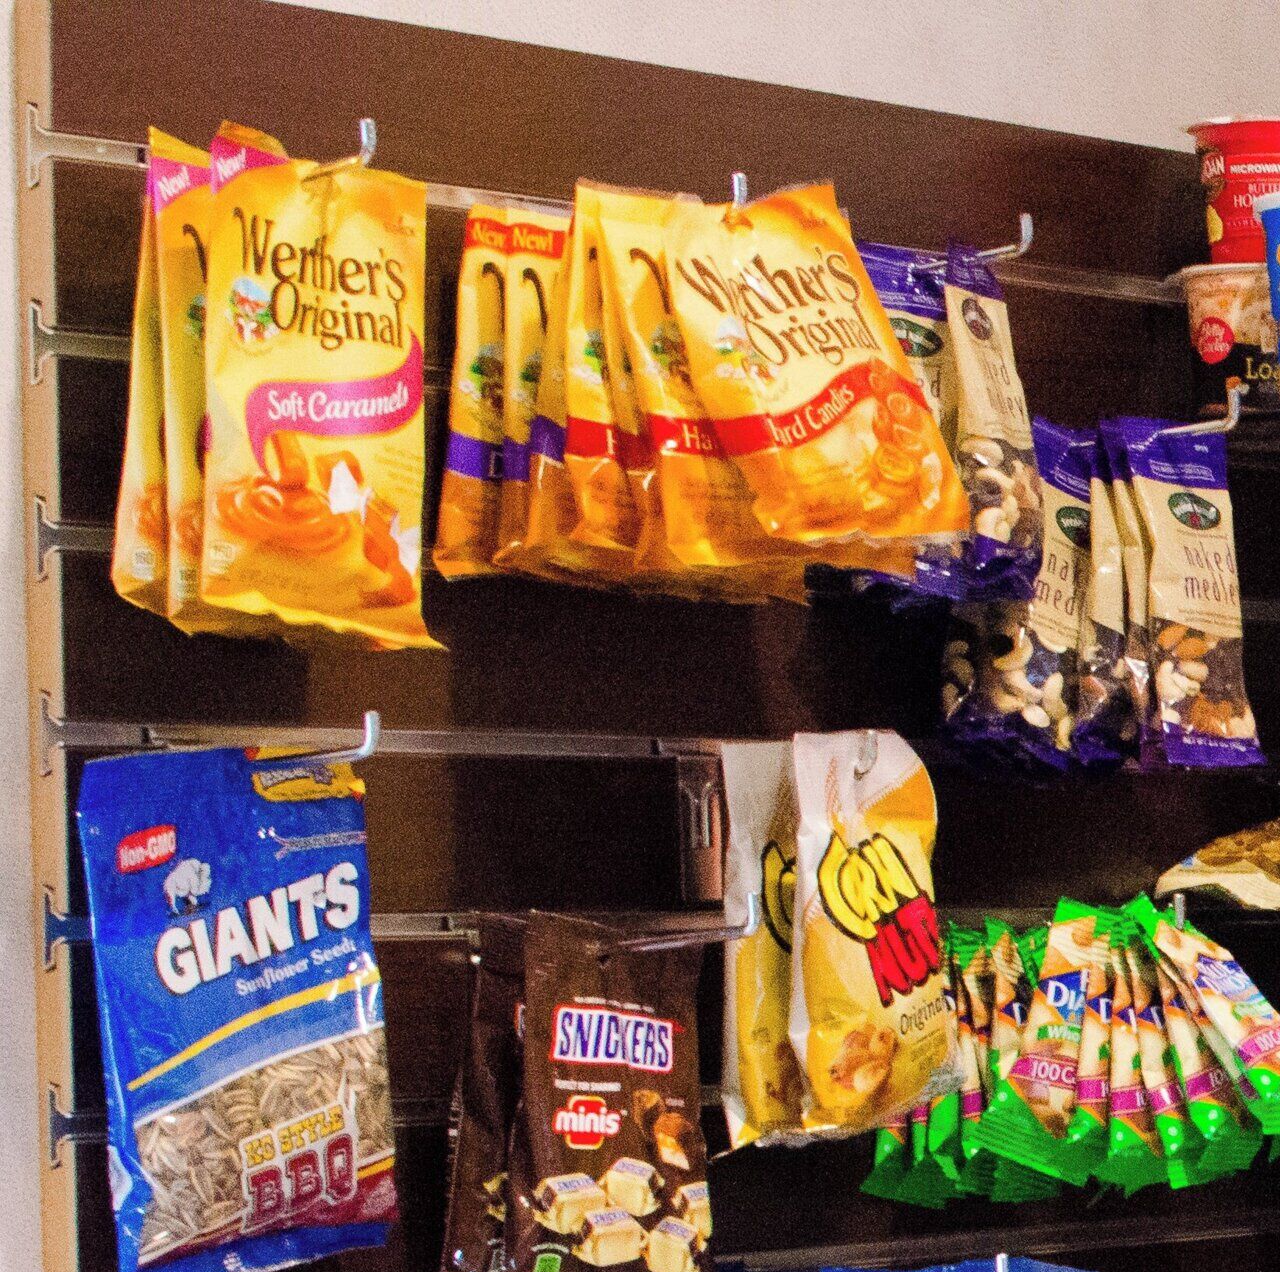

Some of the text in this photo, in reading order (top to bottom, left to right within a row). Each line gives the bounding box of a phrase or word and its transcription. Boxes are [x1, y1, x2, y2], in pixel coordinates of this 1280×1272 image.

[215, 148, 247, 184] New!
[234, 207, 408, 302] Werther's
[511, 228, 553, 252] New!
[270, 283, 404, 351] Original
[741, 303, 882, 366] Original
[267, 383, 408, 421] Soft Caramels
[1184, 541, 1236, 574] naked
[155, 861, 361, 997] GIANTS
[235, 956, 309, 998] Sunflower
[899, 993, 949, 1036] Original
[558, 1009, 670, 1069] SNICKERS
[278, 1104, 346, 1155] STYLE
[555, 1105, 621, 1135] minis
[248, 1134, 355, 1227] BBQ
